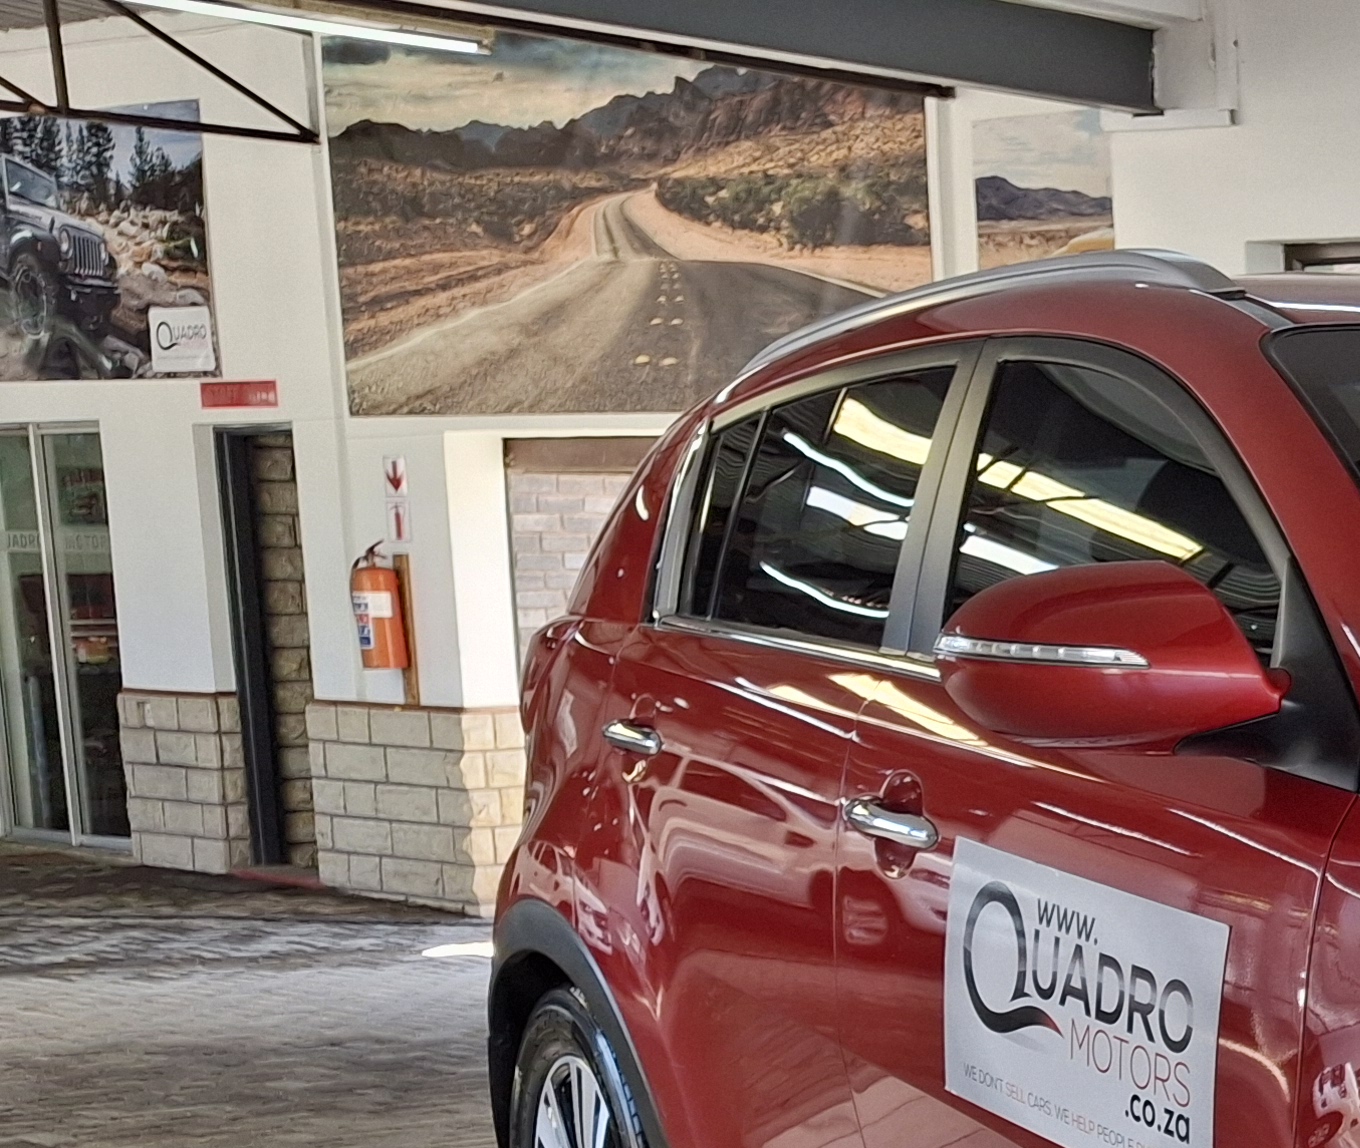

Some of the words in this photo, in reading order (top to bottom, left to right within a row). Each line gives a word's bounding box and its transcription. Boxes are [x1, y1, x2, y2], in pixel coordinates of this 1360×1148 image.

[963, 880, 1194, 1053] QUADRO
[964, 1063, 978, 1082] WE
[1005, 1082, 1026, 1104] SELL
[1054, 1104, 1070, 1125] WE
[1071, 1113, 1095, 1135] HELP
[1070, 1018, 1191, 1107] MOTORS
[1125, 1094, 1190, 1144] .co.za
